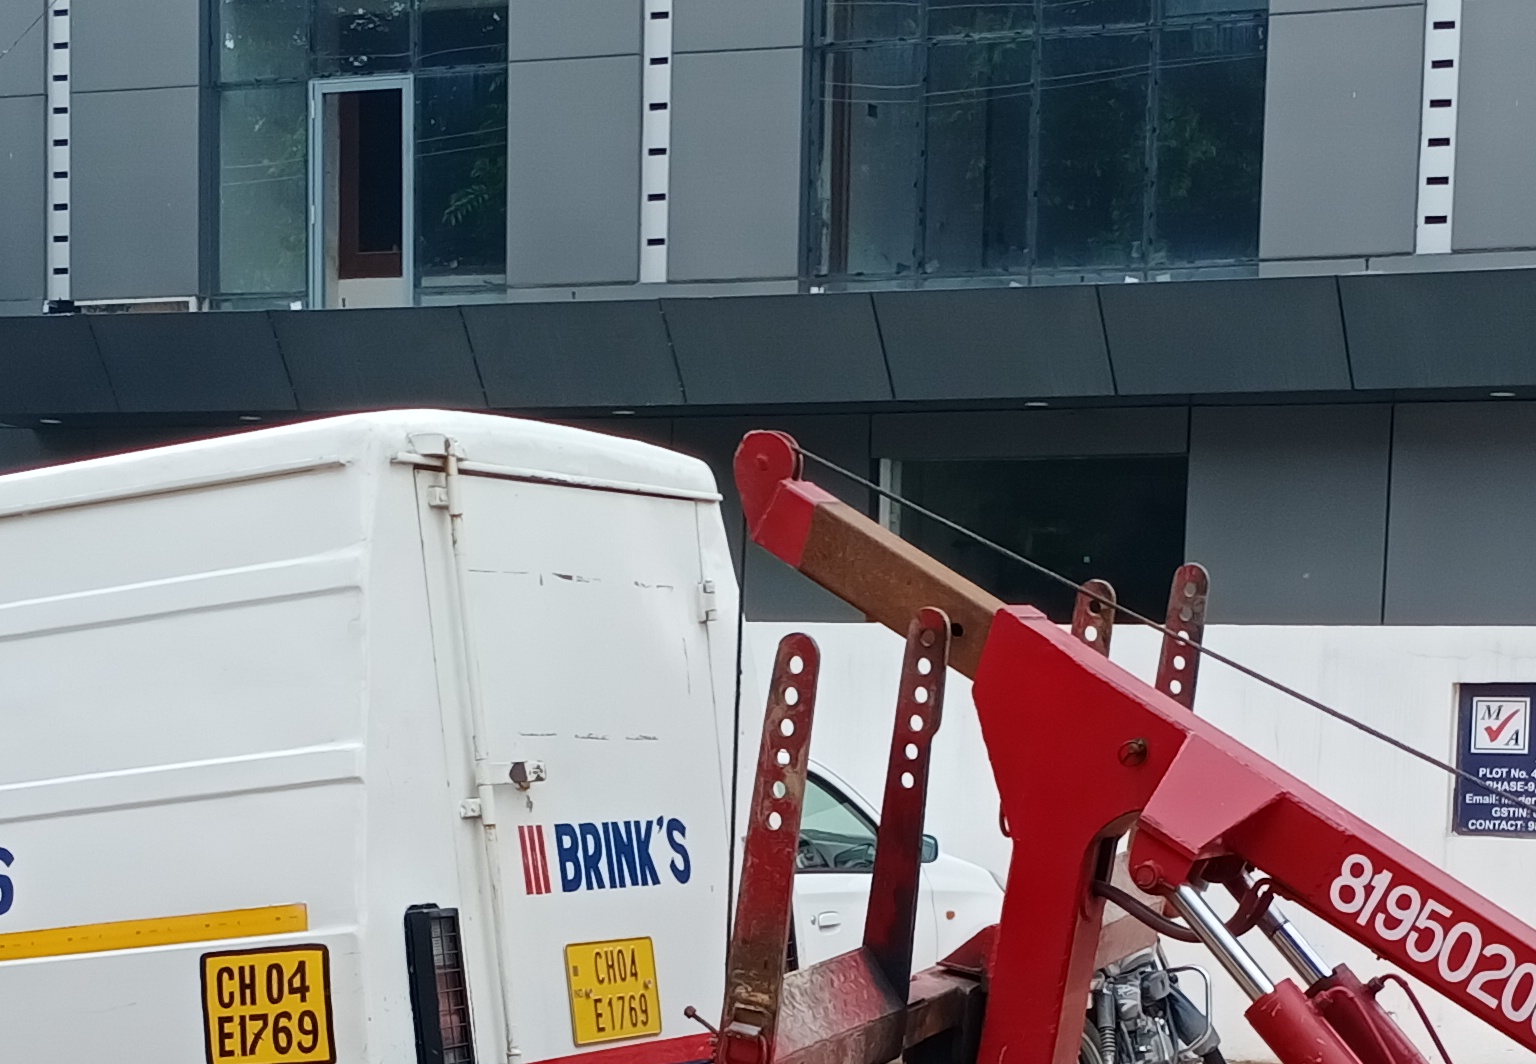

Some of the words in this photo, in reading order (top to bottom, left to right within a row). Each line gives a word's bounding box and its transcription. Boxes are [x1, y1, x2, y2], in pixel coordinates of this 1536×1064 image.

[1480, 704, 1504, 721] M
[1504, 728, 1521, 747] A
[1479, 768, 1508, 778] PLOT
[1511, 768, 1529, 779] No.
[1465, 793, 1499, 804] Email:
[1492, 807, 1530, 818] GSTIN:
[1468, 820, 1524, 831] CONTACT:
[554, 815, 691, 892] BRINK'S
[216, 965, 256, 1009] CH
[265, 960, 309, 1003] 04
[593, 993, 649, 1032] E1769
[218, 1010, 319, 1060] E1769
